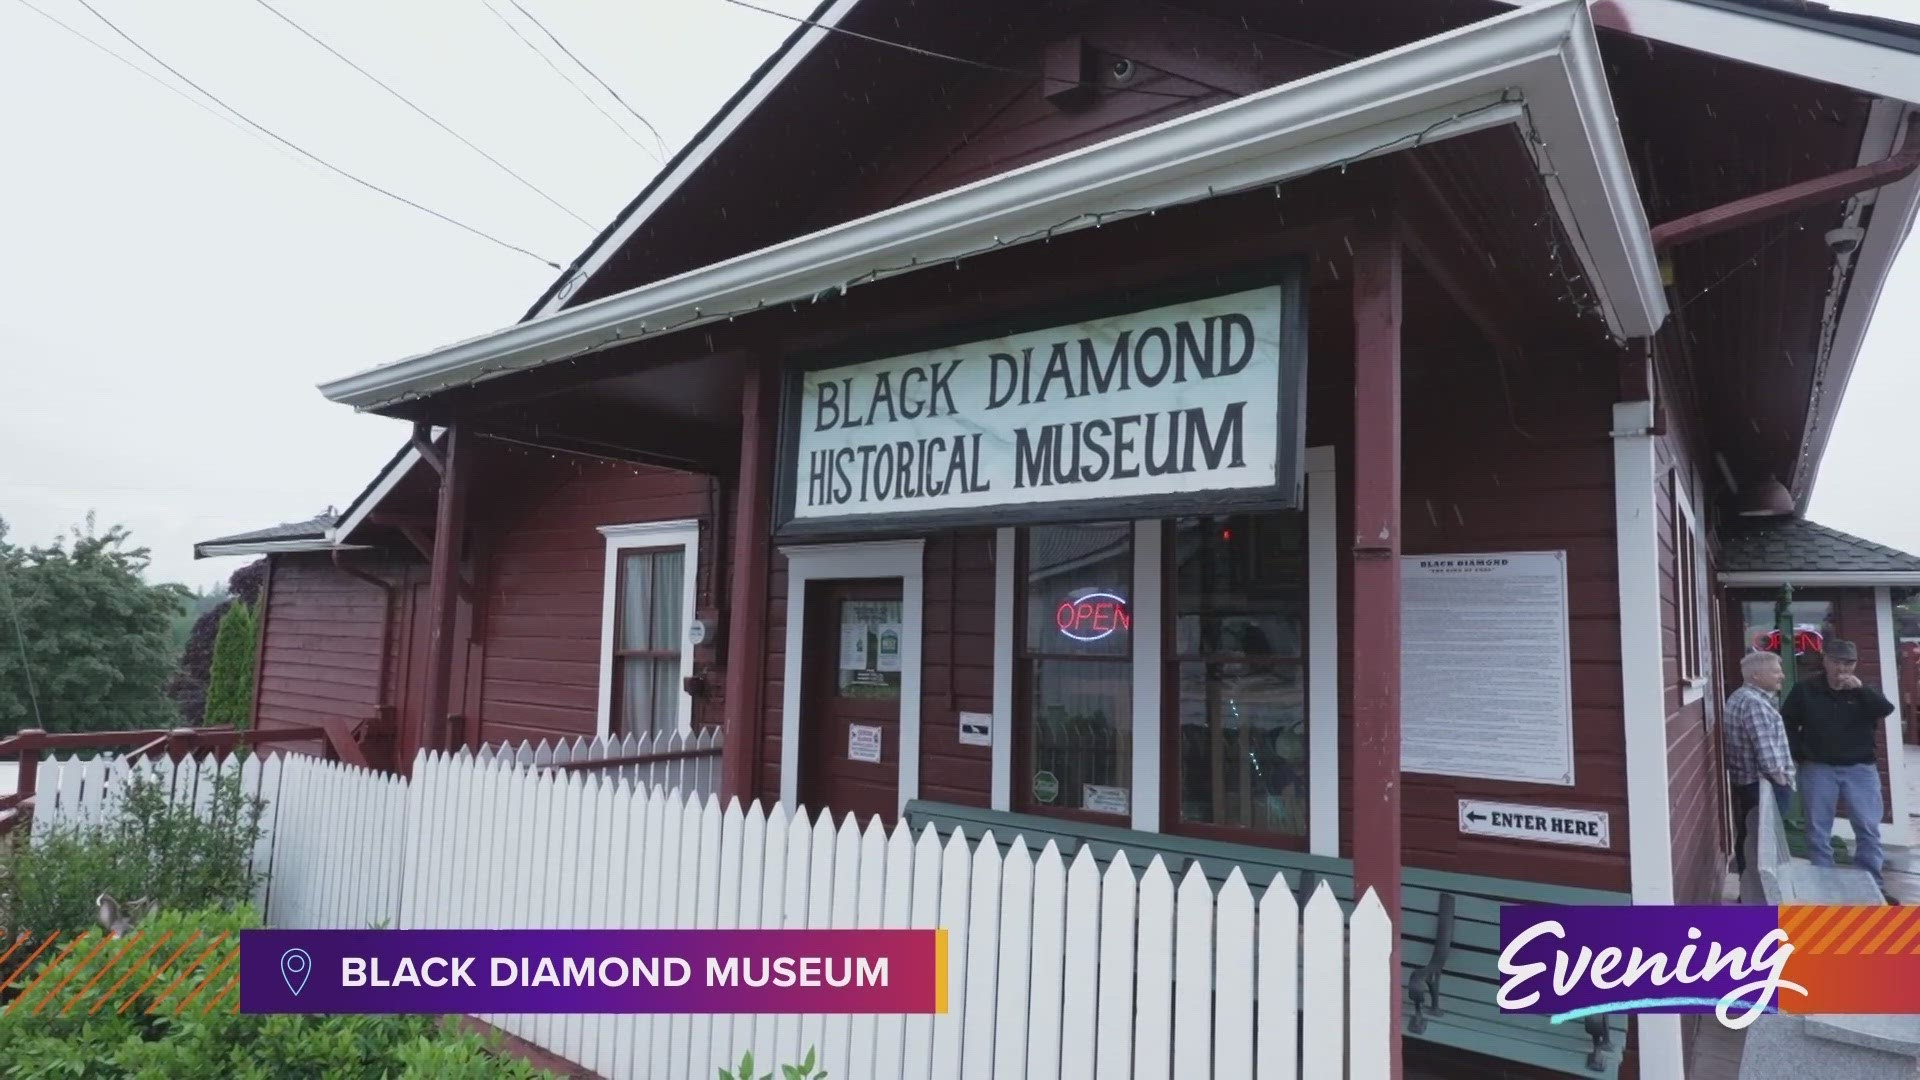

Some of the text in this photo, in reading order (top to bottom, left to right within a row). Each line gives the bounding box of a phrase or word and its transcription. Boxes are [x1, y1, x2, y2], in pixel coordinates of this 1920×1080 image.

[814, 313, 1255, 432] BLACK DIAMOND
[808, 401, 1248, 507] HISTORICAL MUSEUM
[1420, 559, 1510, 569] BLACK DIAMOND
[1056, 602, 1130, 630] OPEN
[1491, 811, 1599, 837] ENTER HERE
